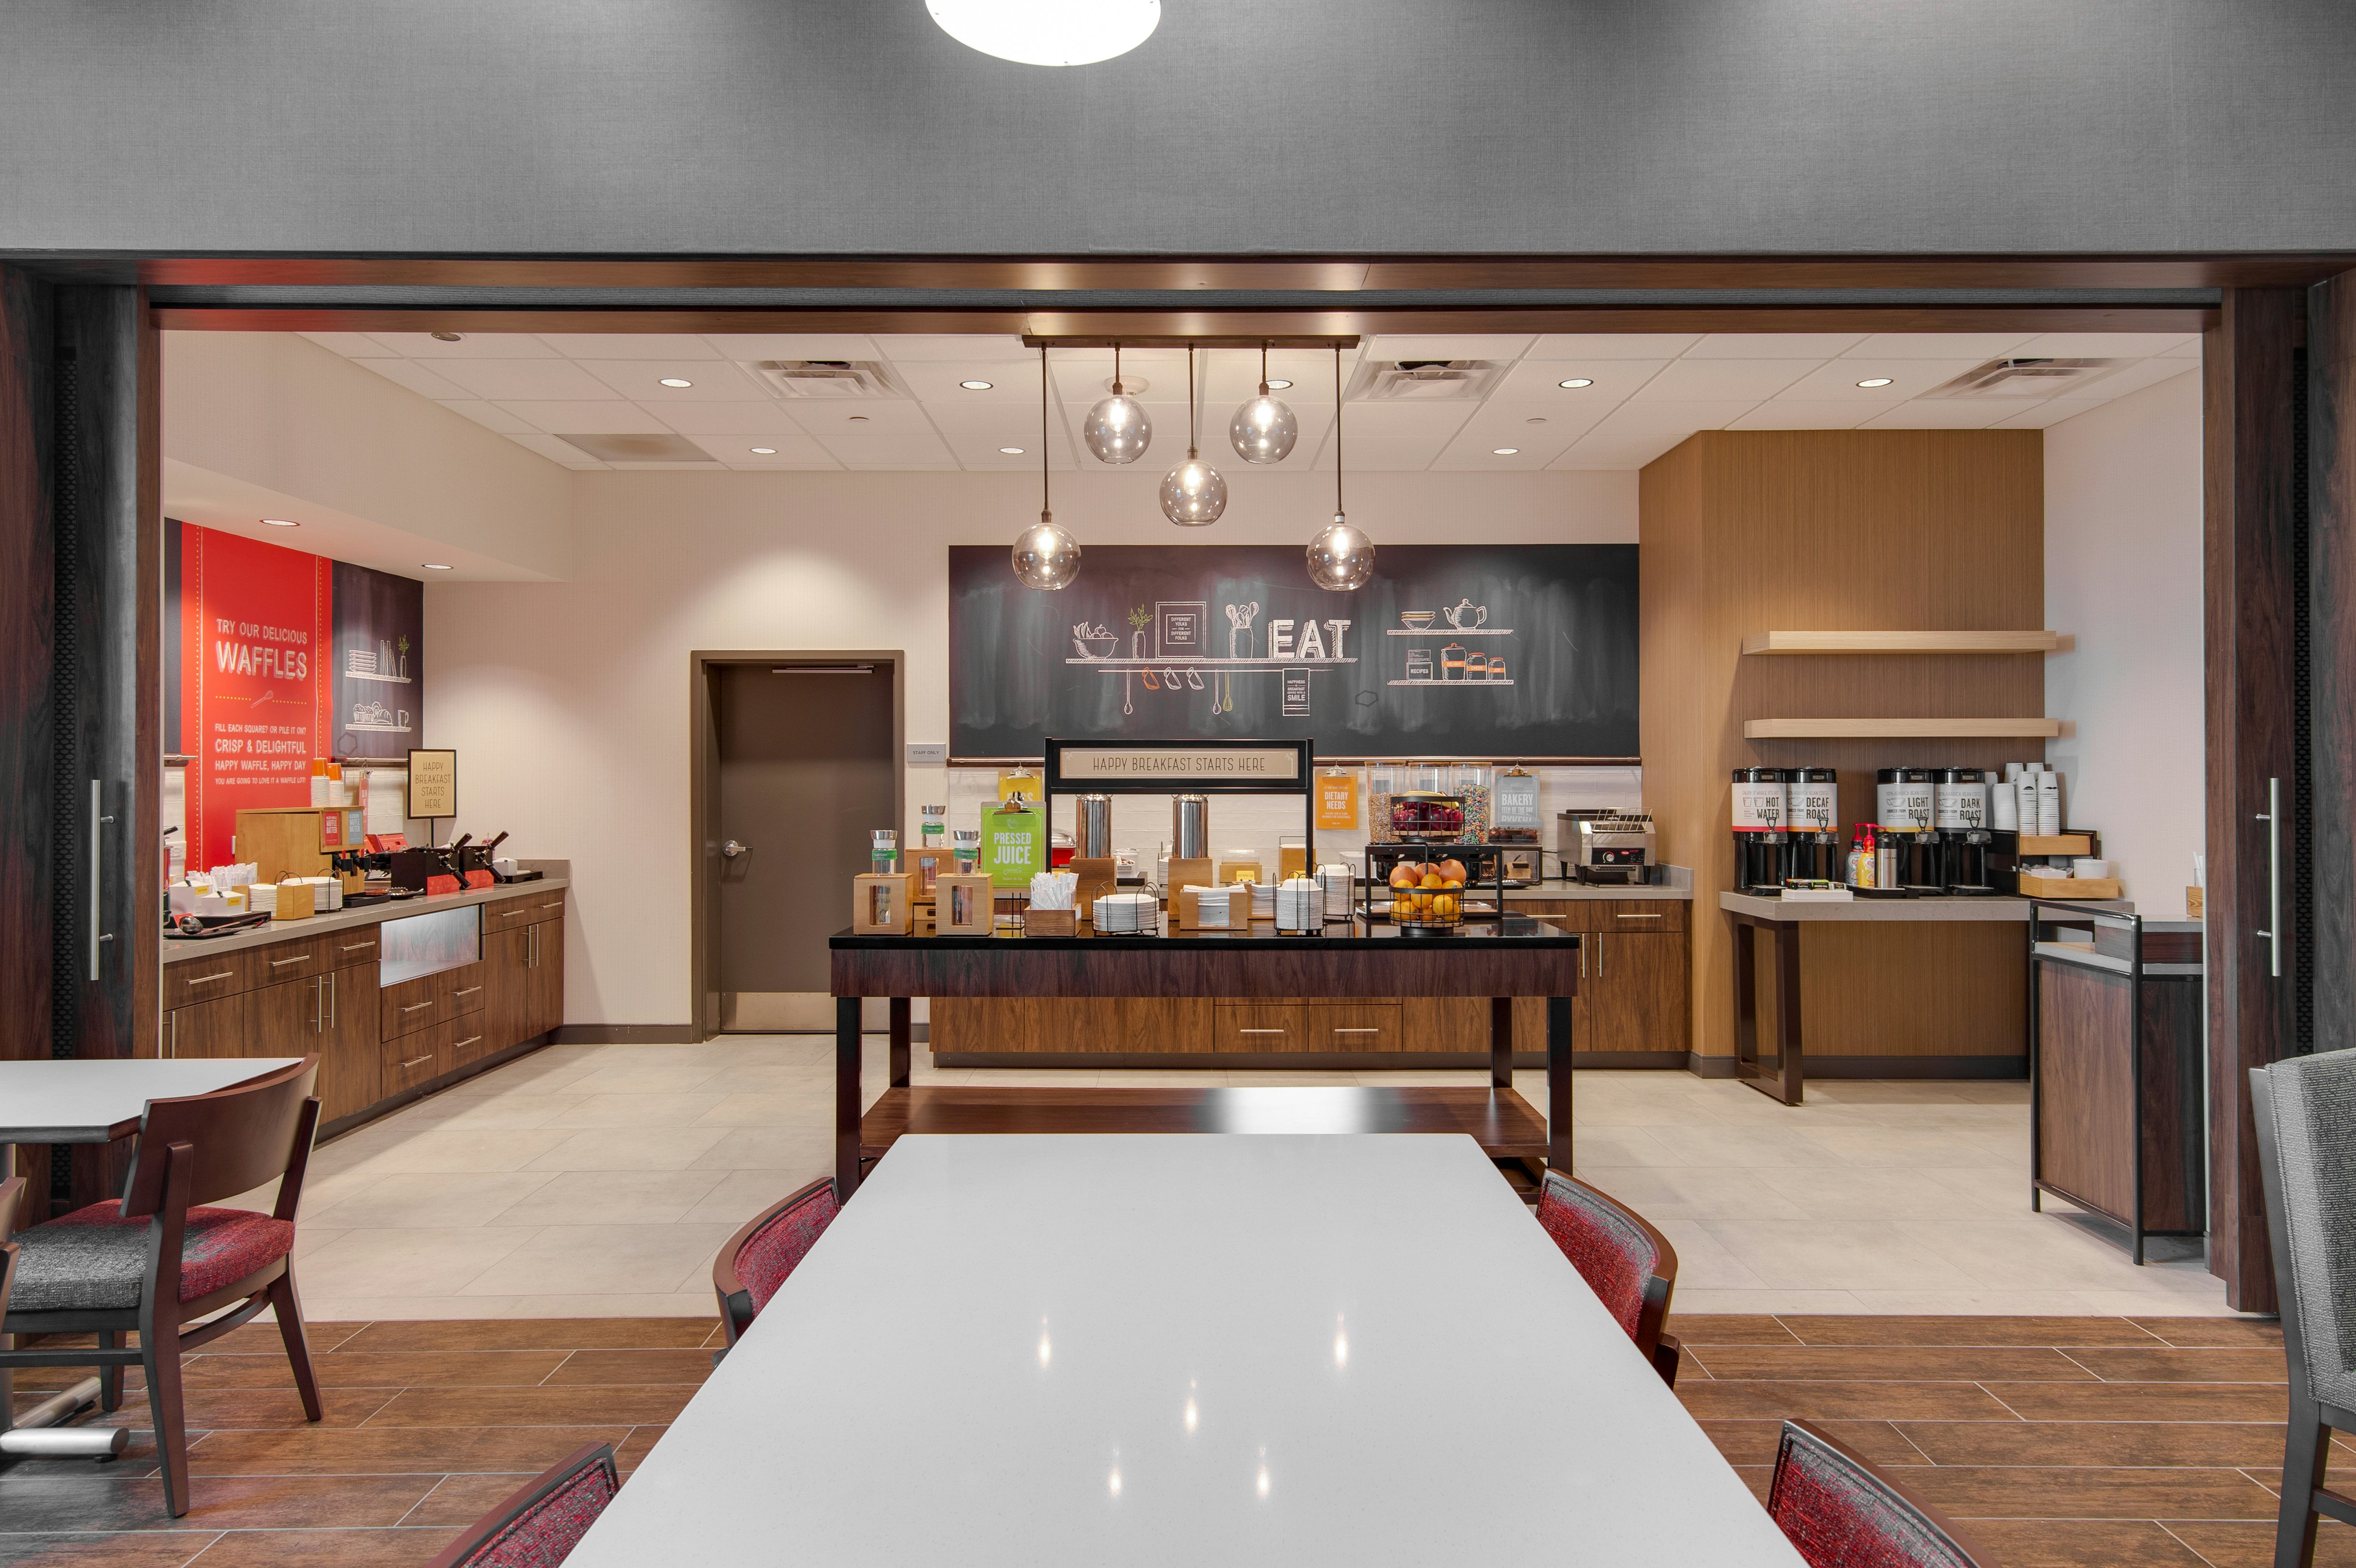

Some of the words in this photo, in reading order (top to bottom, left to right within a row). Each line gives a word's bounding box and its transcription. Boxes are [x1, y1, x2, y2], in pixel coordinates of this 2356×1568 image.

[217, 619, 235, 635] TRY
[240, 622, 260, 638] OUR
[263, 626, 307, 645] DELICIOUS
[1268, 619, 1351, 659] EAT
[216, 640, 307, 681] WAFFLES
[215, 724, 226, 732] FILL
[228, 724, 242, 732] EACH
[245, 725, 268, 734] SQUARE?
[215, 739, 243, 753] CRISP
[247, 739, 252, 753] &
[256, 740, 306, 754] DELIGHTFUL
[215, 760, 238, 770] HAPPY
[241, 760, 269, 771] WAFFLE,
[271, 761, 292, 770] HAPPY
[294, 761, 306, 770] DAY
[423, 762, 443, 771] HAPPY
[1093, 757, 1127, 771] HAPPY
[1132, 757, 1192, 771] BREAKFAST
[1196, 757, 1234, 771] STARTS
[1239, 757, 1265, 771] HERE
[416, 774, 451, 784] BREAKFAST
[421, 787, 444, 796] STARTS
[1325, 791, 1348, 800] DIETARY
[425, 799, 441, 808] HERE
[1502, 794, 1533, 805] BAKERY
[1766, 797, 1779, 807] HOT
[1807, 797, 1829, 807] DECAF
[1908, 797, 1928, 807] LIGHT
[1961, 798, 1980, 808] DARK
[1327, 801, 1346, 809] NEEDS
[1757, 809, 1779, 818] WATER
[1807, 809, 1829, 819] ROAST
[1909, 809, 1929, 819] ROAST
[1960, 810, 1981, 820] ROAST
[994, 832, 1031, 844] PRESSED
[993, 846, 1031, 864] JUICE
